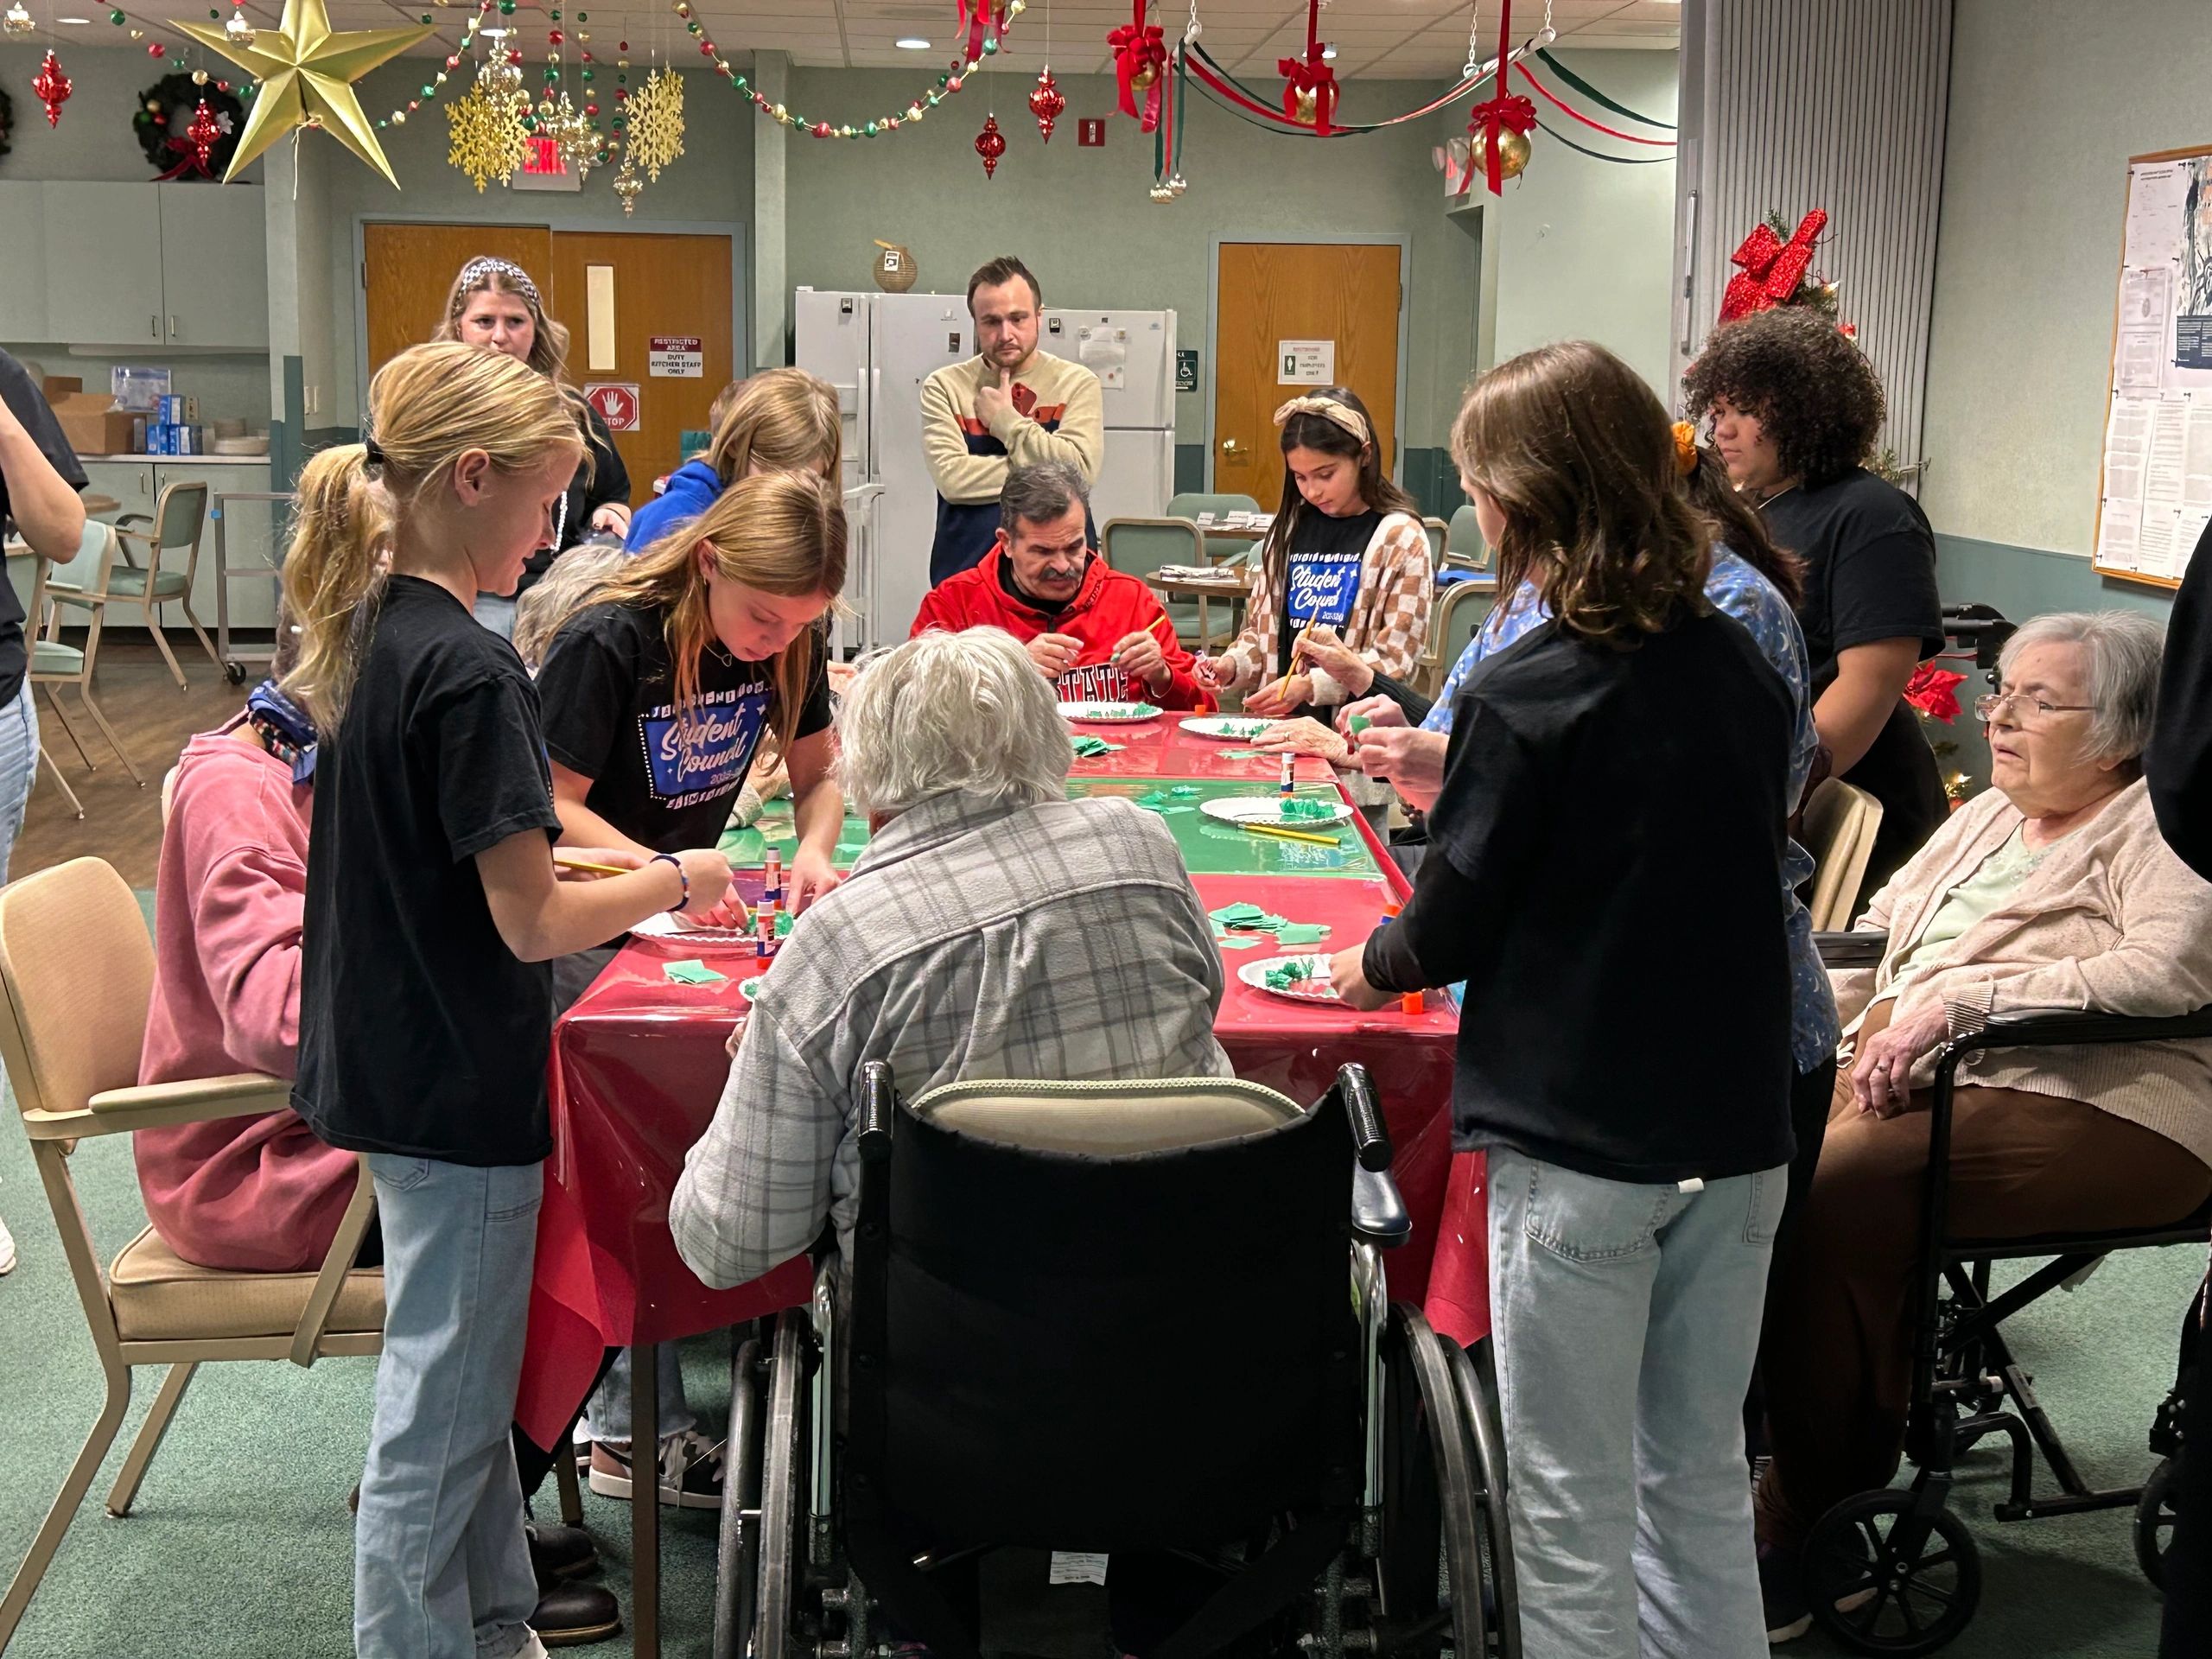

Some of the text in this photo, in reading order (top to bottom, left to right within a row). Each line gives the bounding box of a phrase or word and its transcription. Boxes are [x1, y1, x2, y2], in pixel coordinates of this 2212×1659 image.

[524, 137, 567, 175] EXI
[1290, 565, 1346, 592] Student
[1057, 663, 1128, 702] TATE
